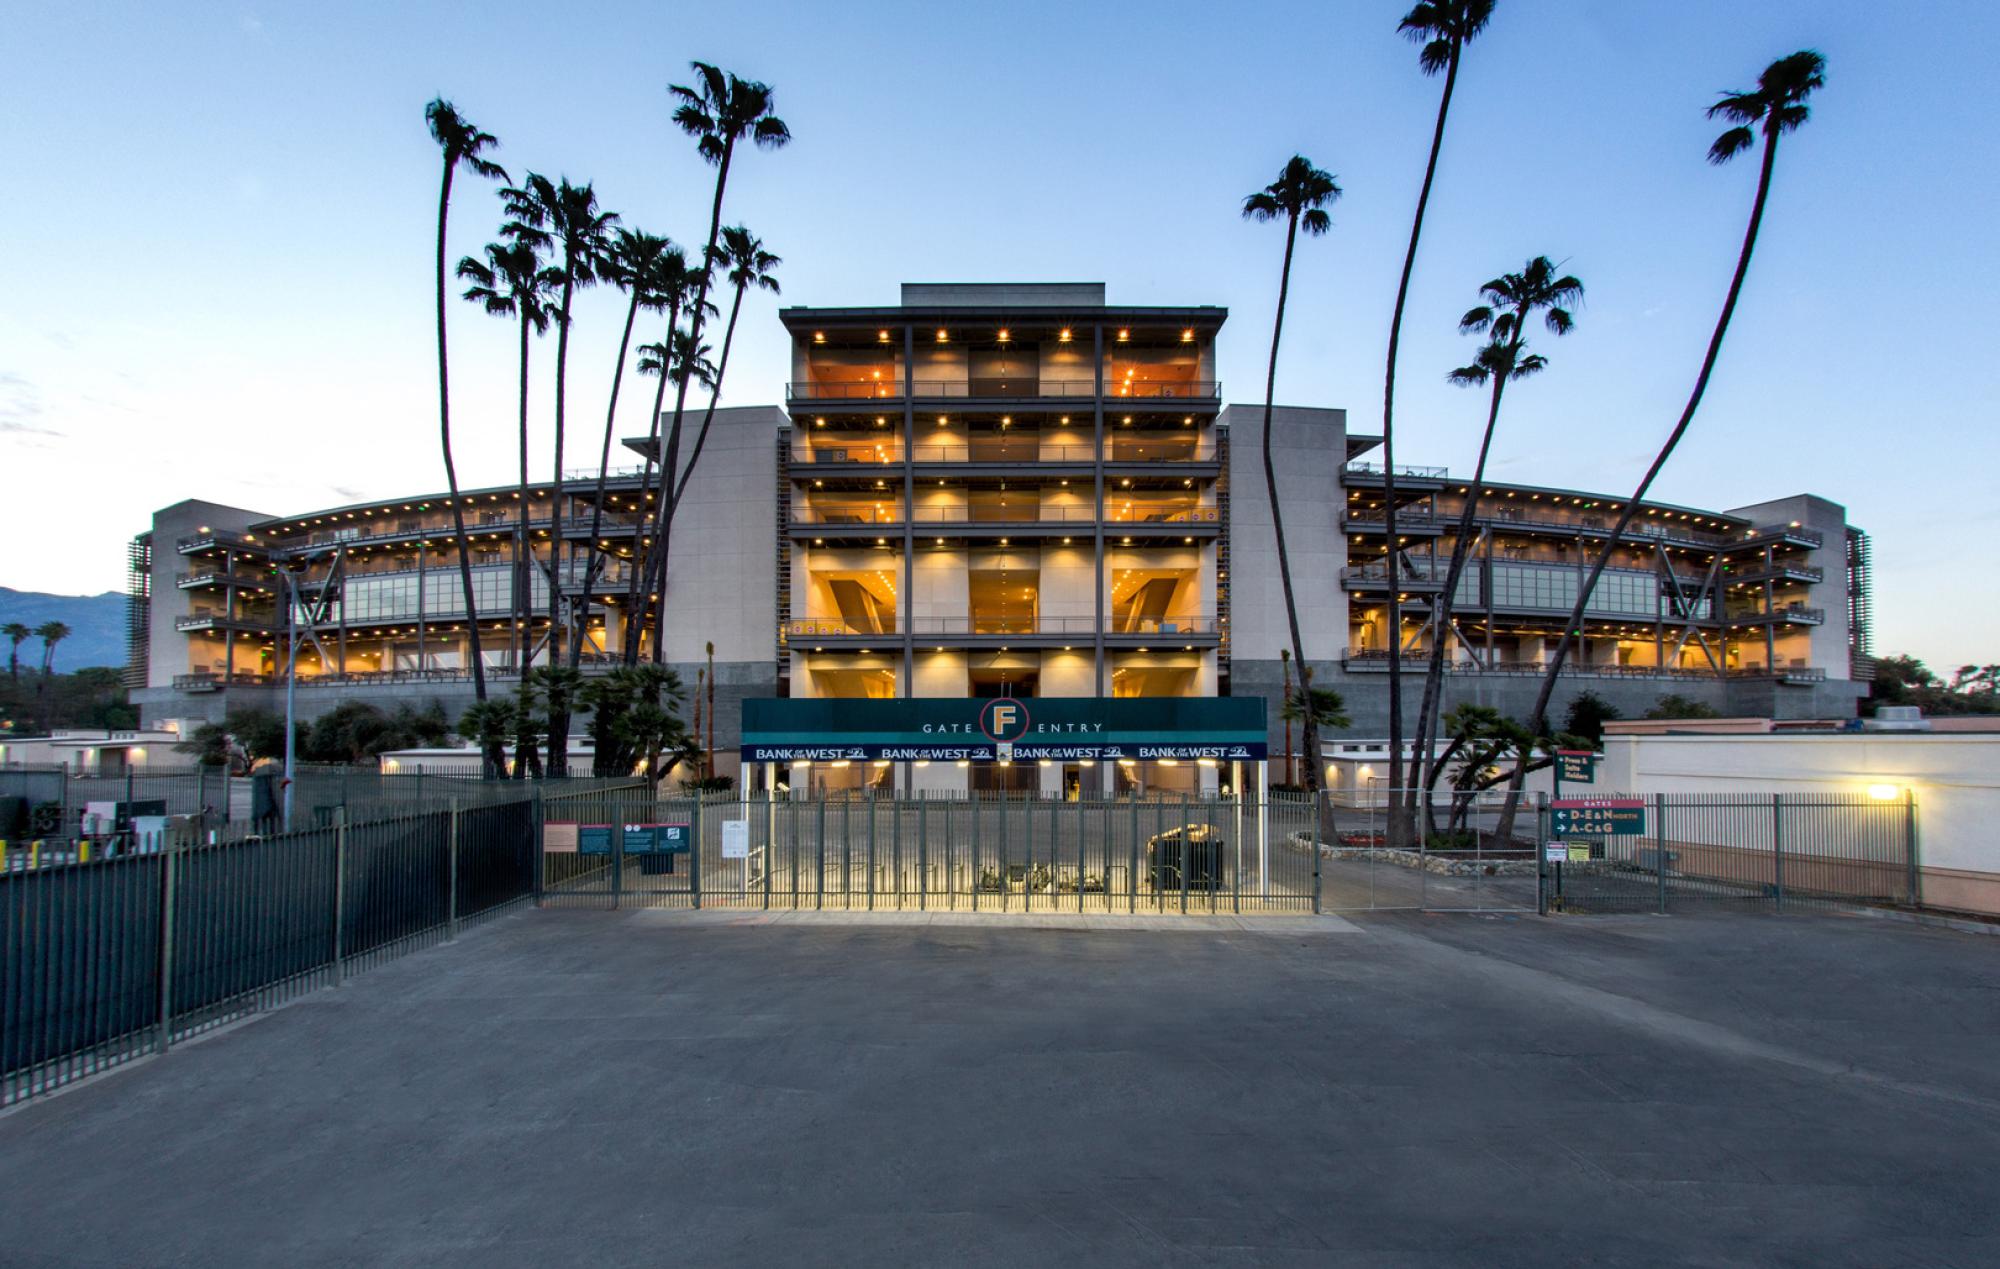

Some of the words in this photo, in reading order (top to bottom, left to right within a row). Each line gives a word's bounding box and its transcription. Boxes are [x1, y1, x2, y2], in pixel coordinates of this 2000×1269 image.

[922, 723, 972, 733] GATE
[993, 705, 1016, 735] F
[1037, 723, 1102, 733] ENTRY
[755, 749, 794, 759] BANK
[805, 749, 846, 759] WEST
[881, 748, 919, 759] BANK
[931, 748, 971, 759] WEST
[1013, 748, 1051, 758] BANK
[1063, 747, 1103, 758] WEST
[1139, 747, 1176, 758] BANK
[1188, 747, 1229, 757] WEST
[1594, 825, 1602, 833] &
[1603, 823, 1613, 833] G
